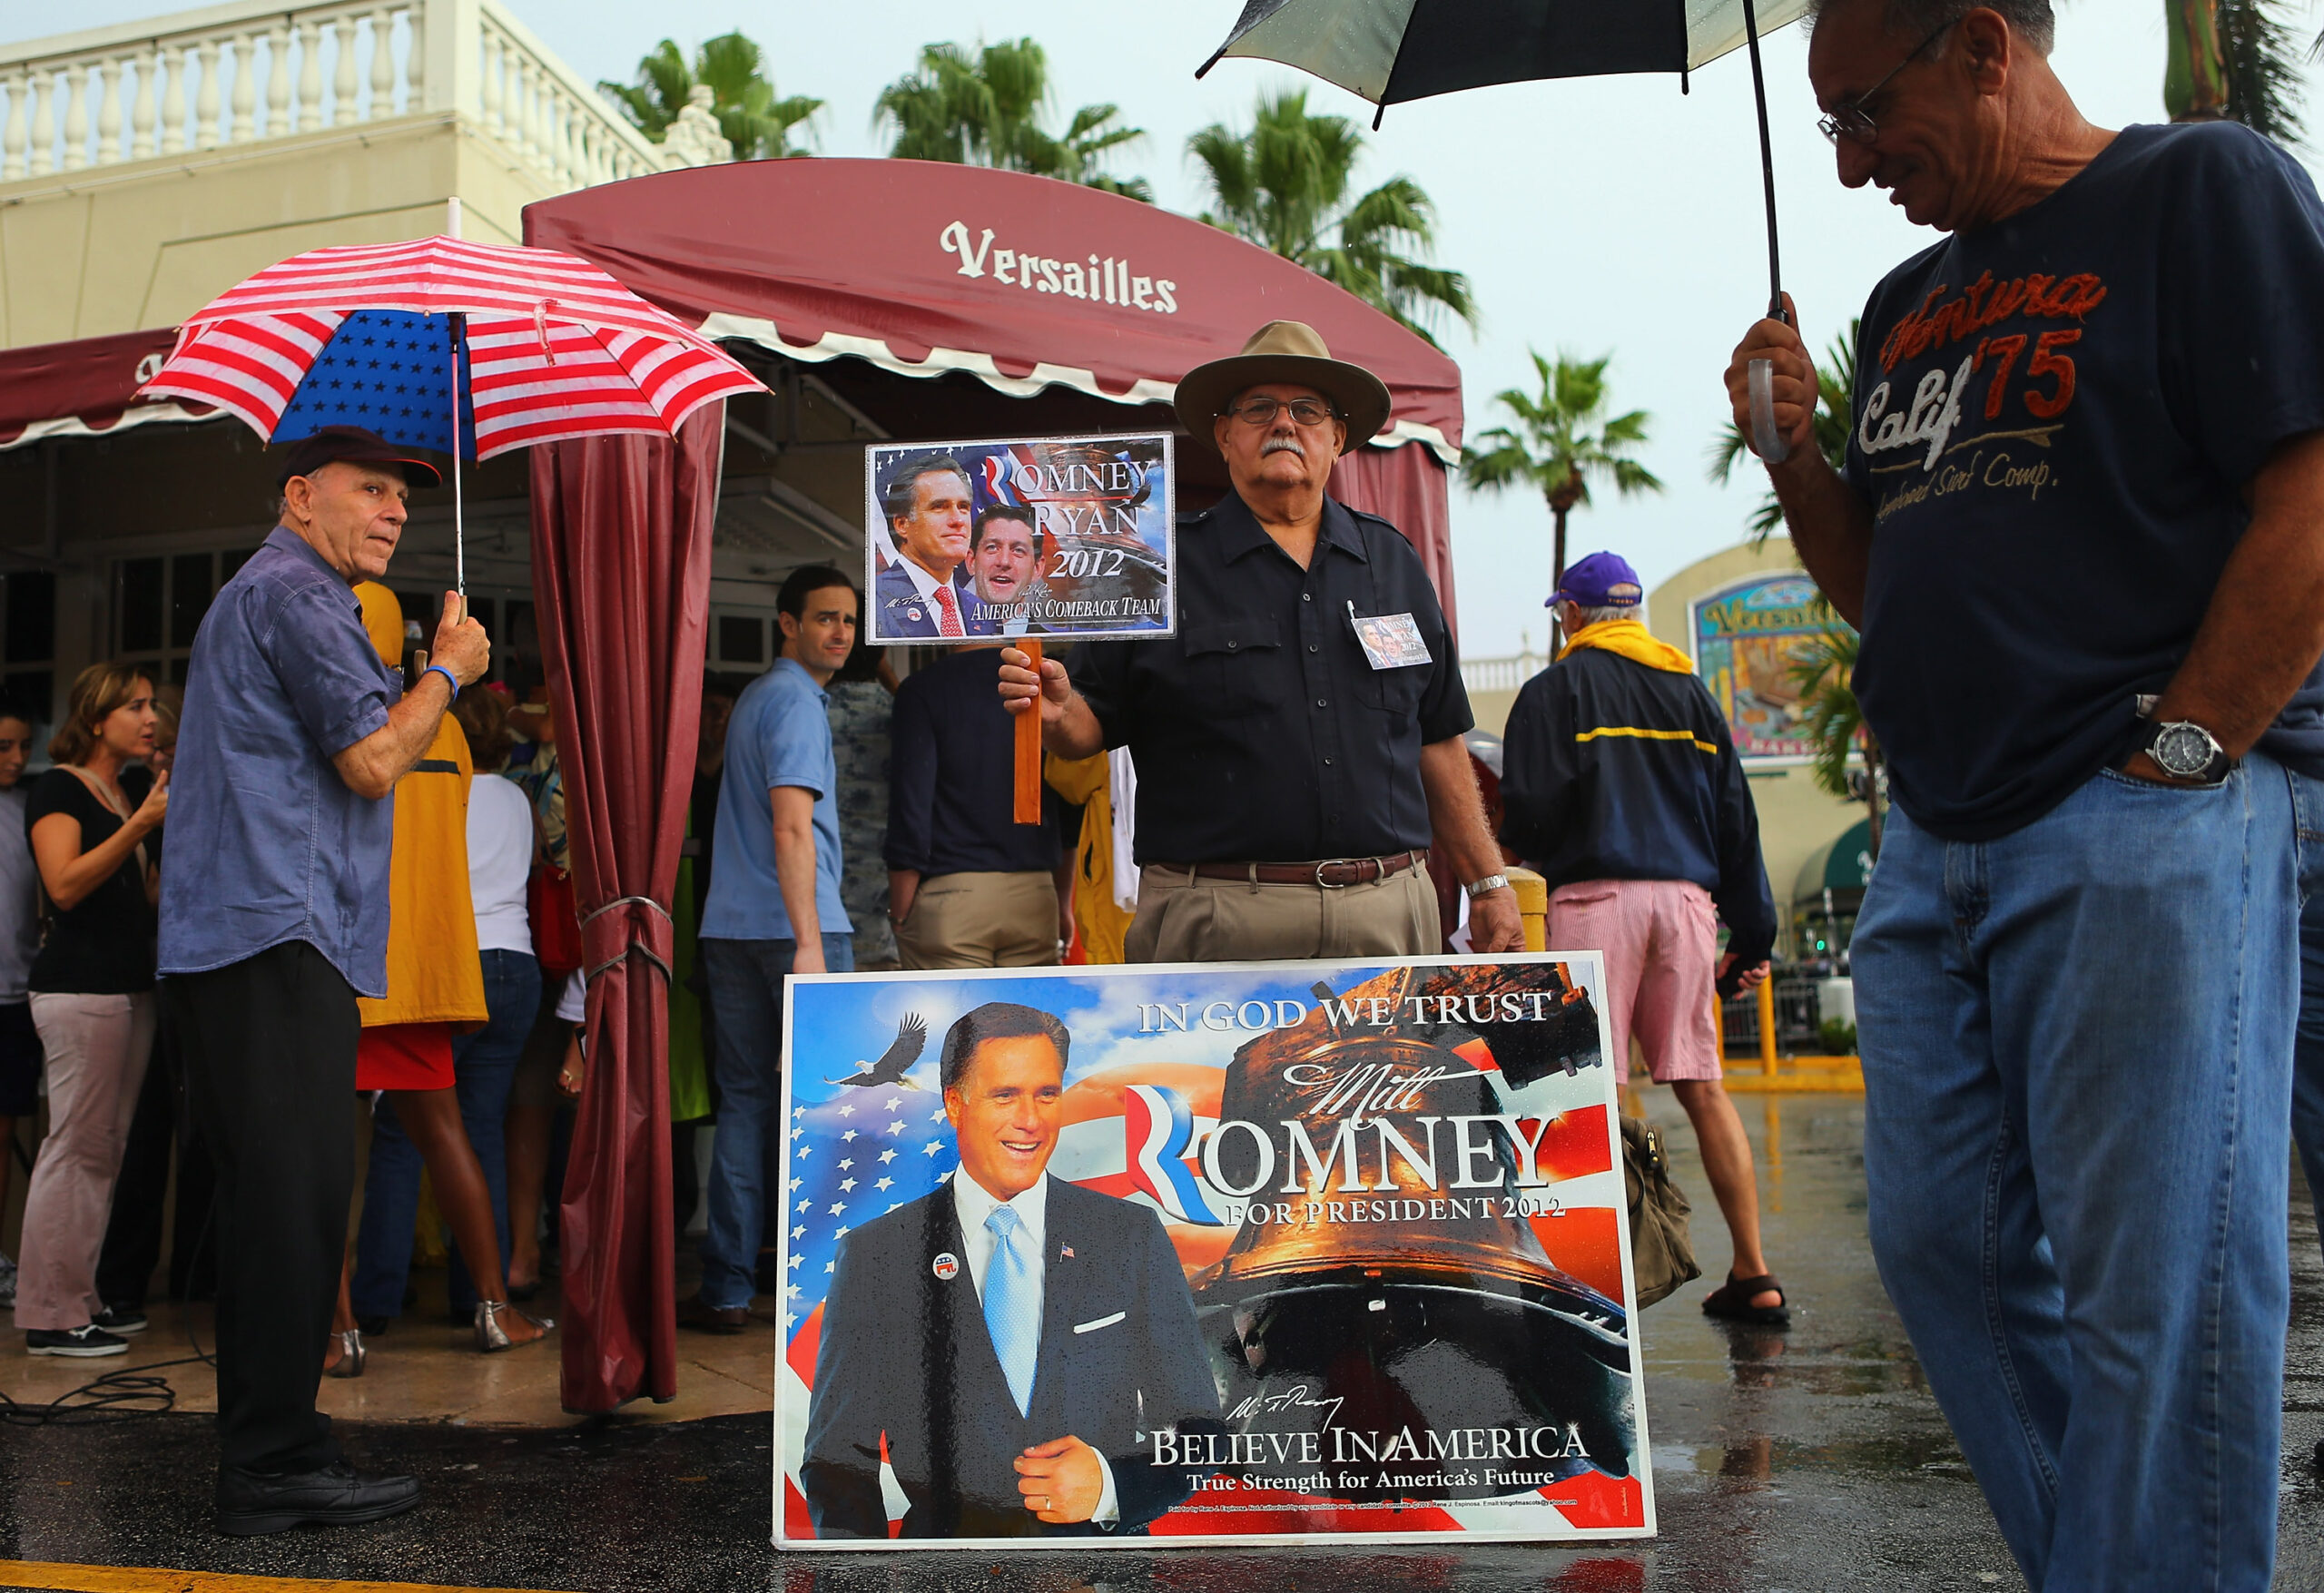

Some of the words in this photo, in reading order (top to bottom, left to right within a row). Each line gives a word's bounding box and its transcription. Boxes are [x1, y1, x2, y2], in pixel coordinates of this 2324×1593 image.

[940, 221, 1177, 314] Versailles
[986, 455, 1154, 507] ROMNEY
[1984, 454, 2059, 500] Comp.
[1031, 502, 1140, 537] RYAN
[1048, 549, 1125, 579] 2012
[970, 602, 1042, 621] AMERICA'S
[1045, 599, 1118, 618] COMEBACK
[1122, 596, 1161, 615] TEAM
[1704, 598, 1837, 636] Versaill
[1138, 1004, 1189, 1034] IN
[1202, 999, 1307, 1032] GOD
[1318, 997, 1400, 1028] WE
[1404, 992, 1551, 1026] TRUST
[1283, 1061, 1497, 1131] Mitt
[1124, 1084, 1559, 1226] ROMNEY
[1226, 1205, 1302, 1227] FOR
[1306, 1196, 1495, 1225] PRESIDENT
[1502, 1195, 1567, 1220] 2012
[1149, 1428, 1321, 1467] BELIEVE
[1329, 1426, 1378, 1464] IN
[1388, 1425, 1591, 1463] AMERICA
[1187, 1473, 1236, 1492] True
[1241, 1472, 1334, 1496] Strength
[1337, 1471, 1369, 1490] for
[1375, 1470, 1478, 1489] America's
[1483, 1469, 1555, 1486] Future
